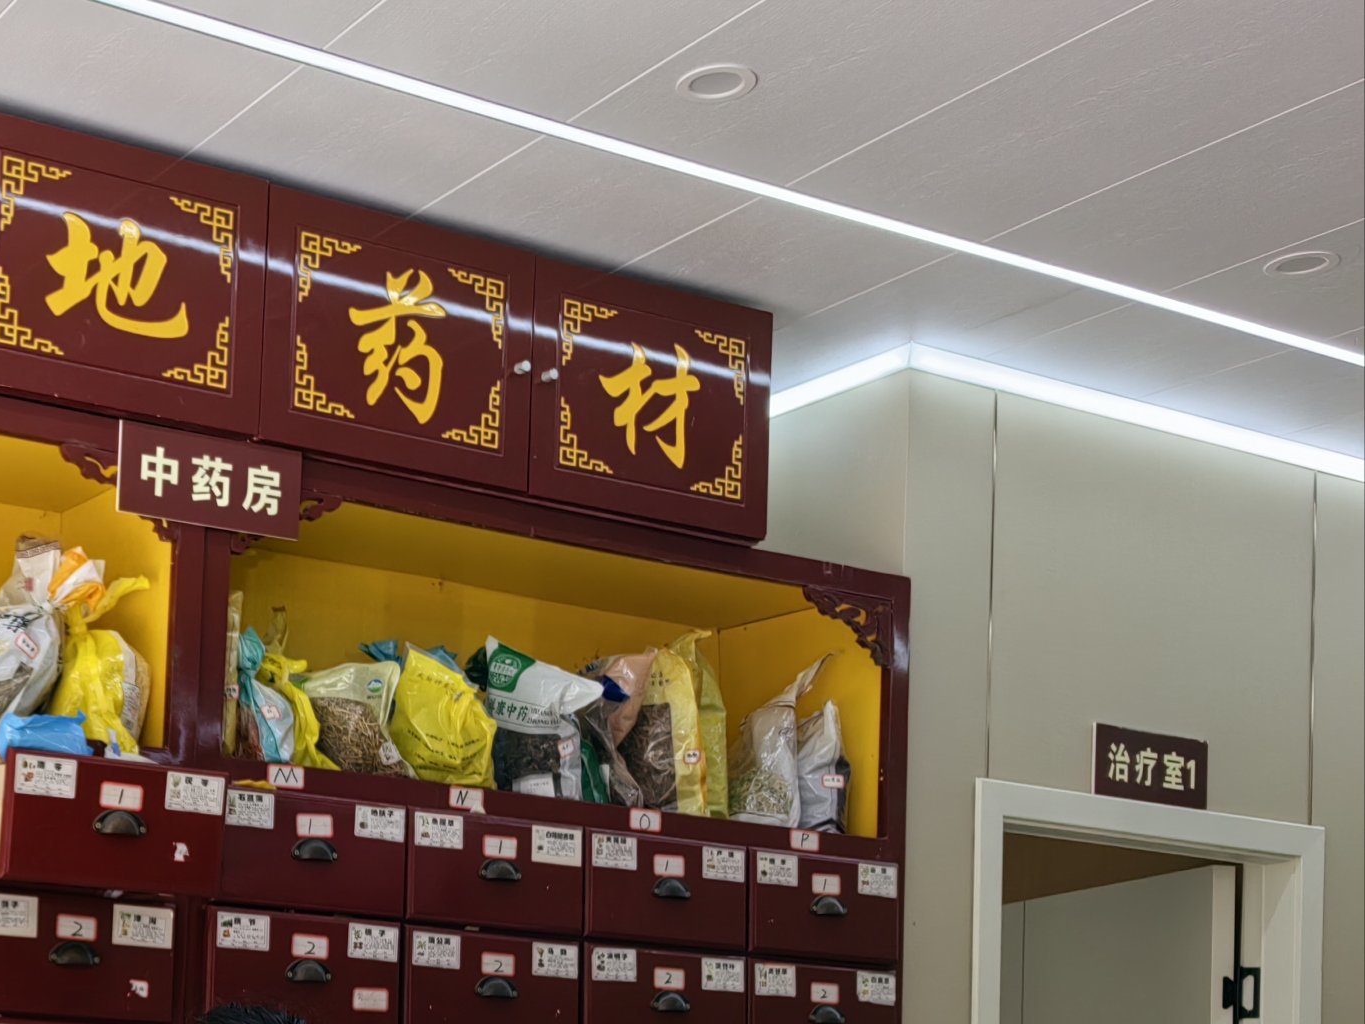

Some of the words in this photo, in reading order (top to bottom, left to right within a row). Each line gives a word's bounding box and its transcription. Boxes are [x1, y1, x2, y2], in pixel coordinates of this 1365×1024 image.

[139, 446, 283, 517] 中药房
[1108, 743, 1196, 790] 治疗室1
[273, 767, 299, 784] M
[456, 790, 469, 805] N
[71, 920, 84, 937] 2
[304, 941, 316, 956] 2
[493, 960, 504, 974] 2
[664, 972, 673, 985] 2
